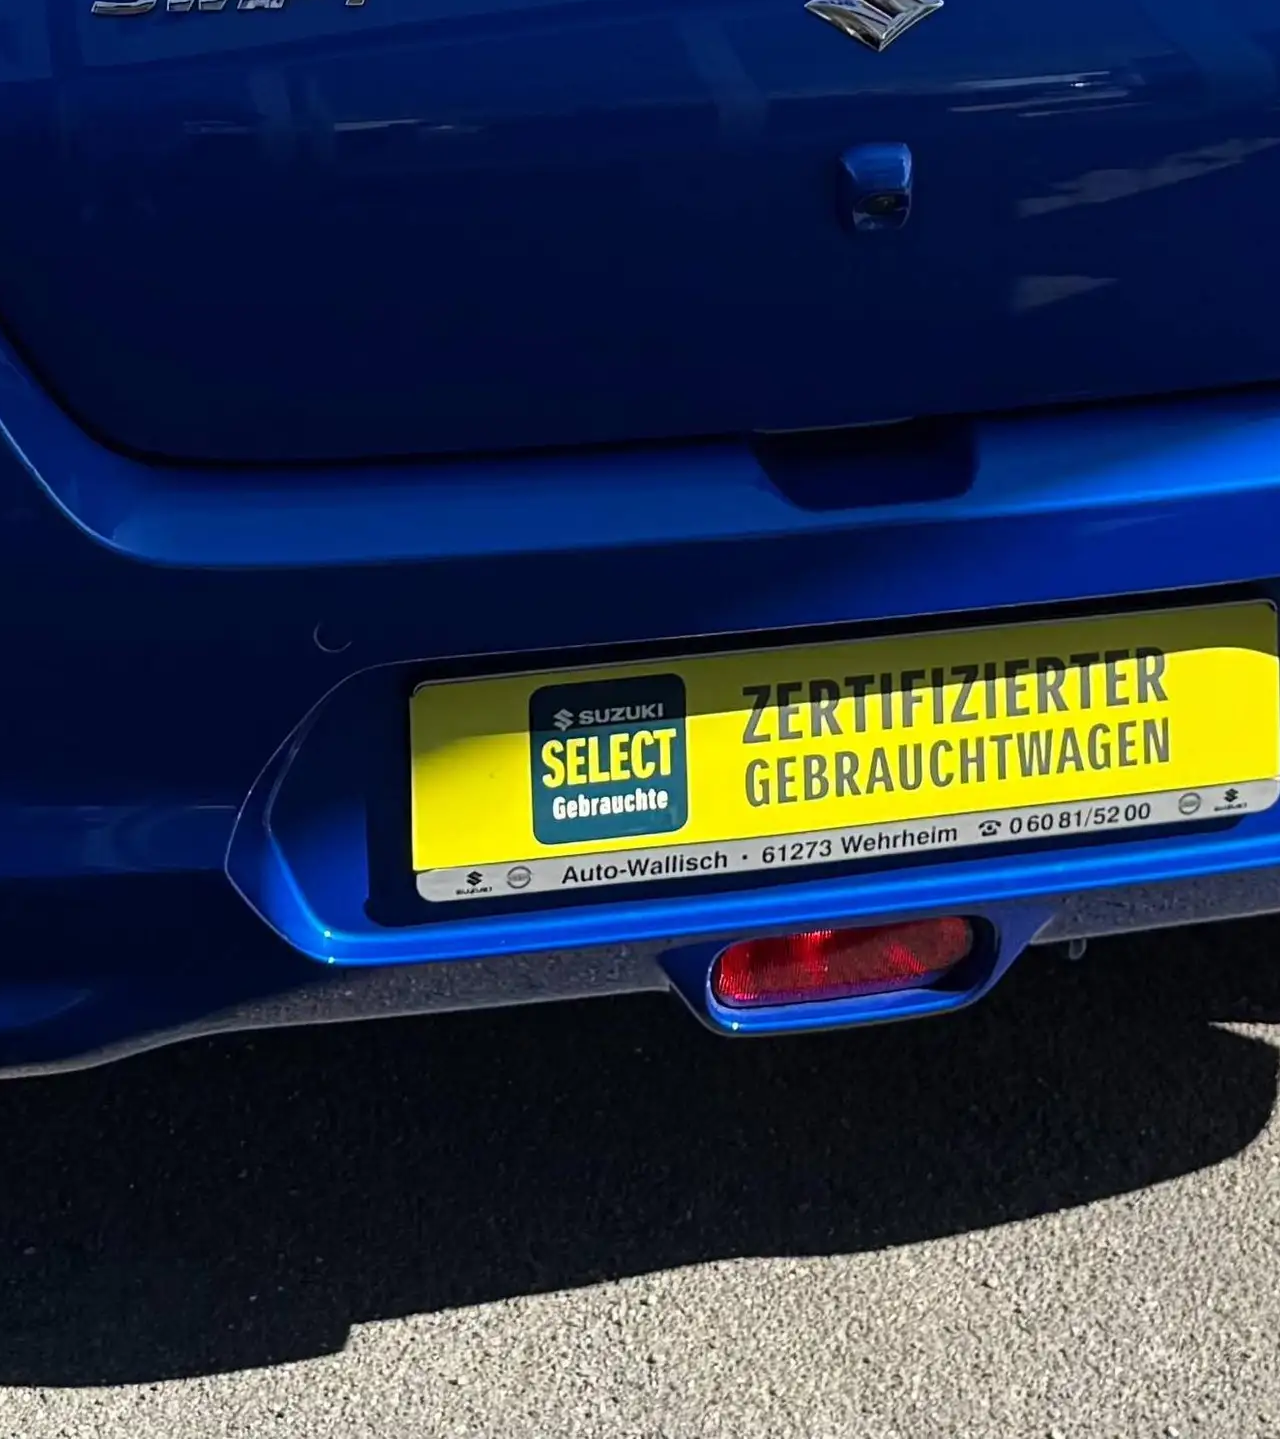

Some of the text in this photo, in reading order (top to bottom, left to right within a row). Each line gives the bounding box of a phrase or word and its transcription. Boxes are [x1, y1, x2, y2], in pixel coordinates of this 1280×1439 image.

[578, 702, 664, 726] SUZUKI
[742, 646, 1169, 744] ZERTIFIZIERTER
[541, 727, 677, 788] SELECT
[745, 717, 1170, 808] GEBRAUCHTWAGEN
[552, 787, 669, 820] Gebrauchte
[561, 850, 728, 885] Auto-Wallisch
[762, 838, 833, 864] 61273
[840, 825, 959, 856] Wehrheim
